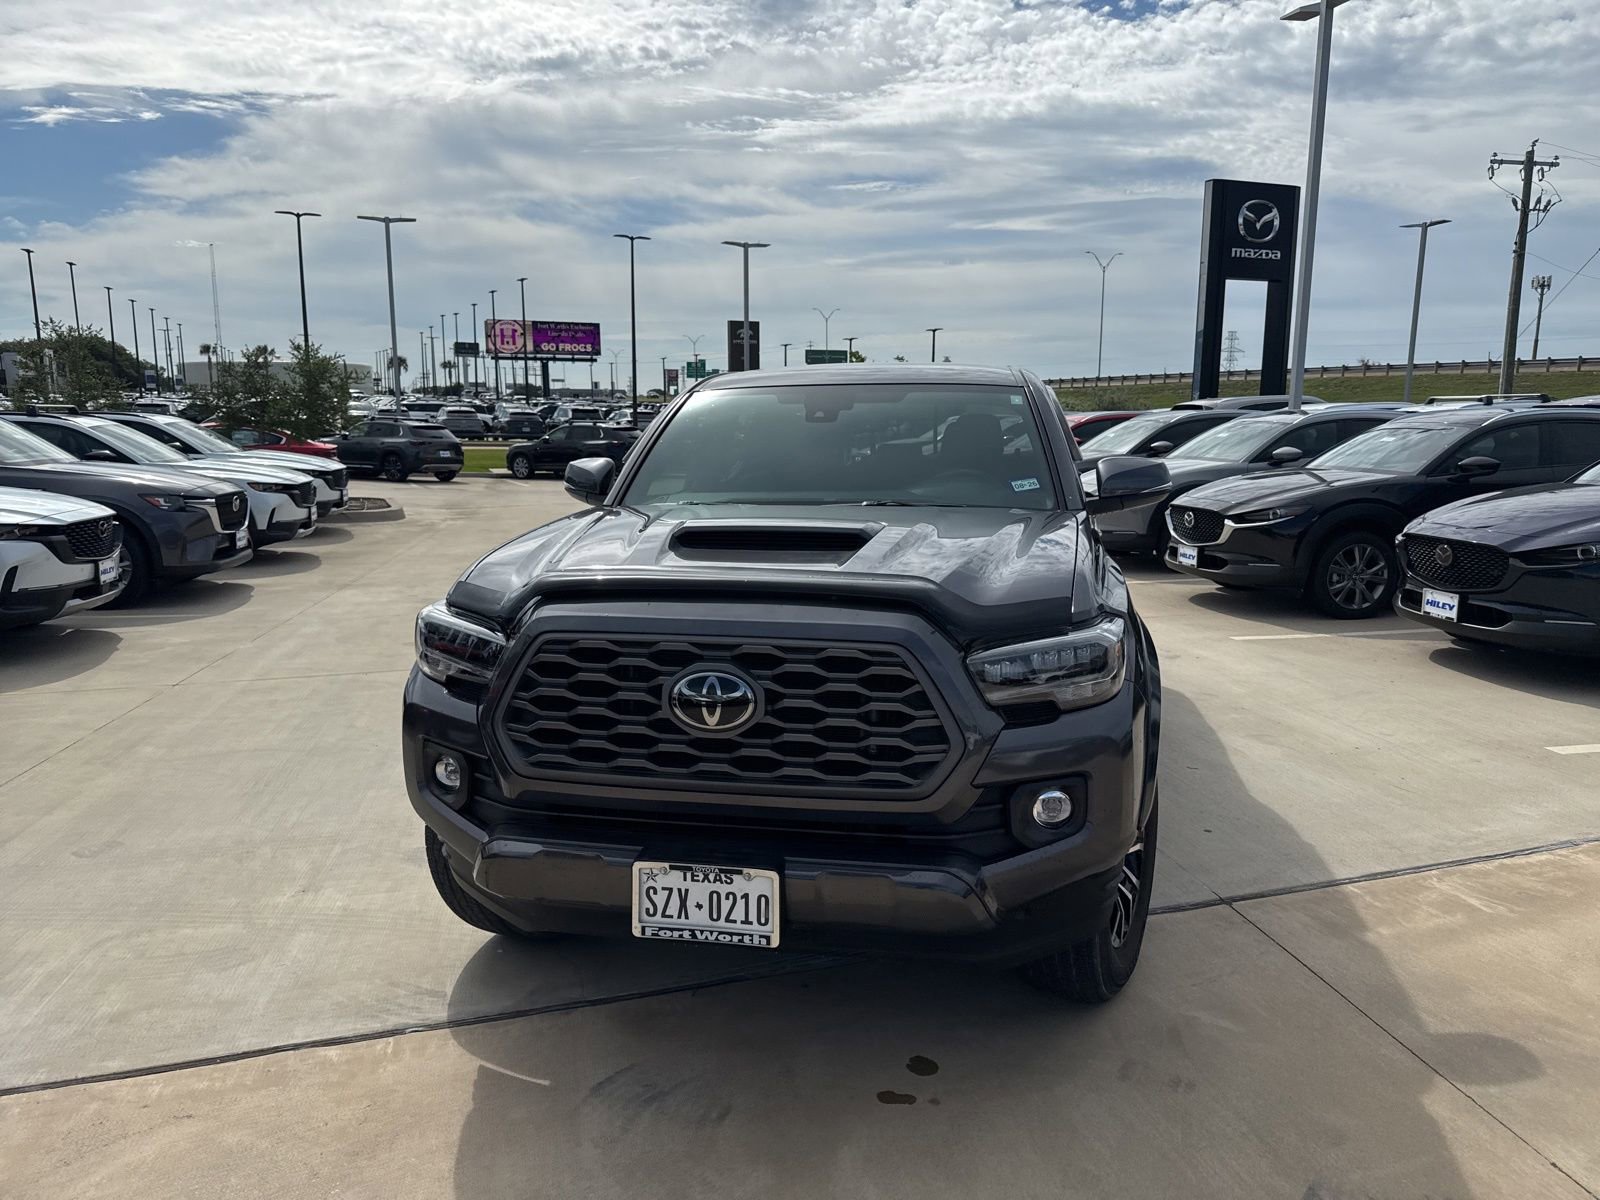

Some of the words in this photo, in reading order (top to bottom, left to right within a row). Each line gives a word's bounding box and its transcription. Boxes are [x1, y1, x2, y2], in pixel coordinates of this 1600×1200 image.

[541, 342, 557, 351] GO
[559, 343, 593, 352] FROGS
[1425, 598, 1456, 611] HILEY
[691, 866, 720, 874] TOYOTA
[681, 870, 734, 885] TEXAS
[645, 885, 690, 920] SZX
[708, 890, 770, 927] 0210
[644, 927, 692, 939] Fort
[694, 930, 767, 946] Worth
